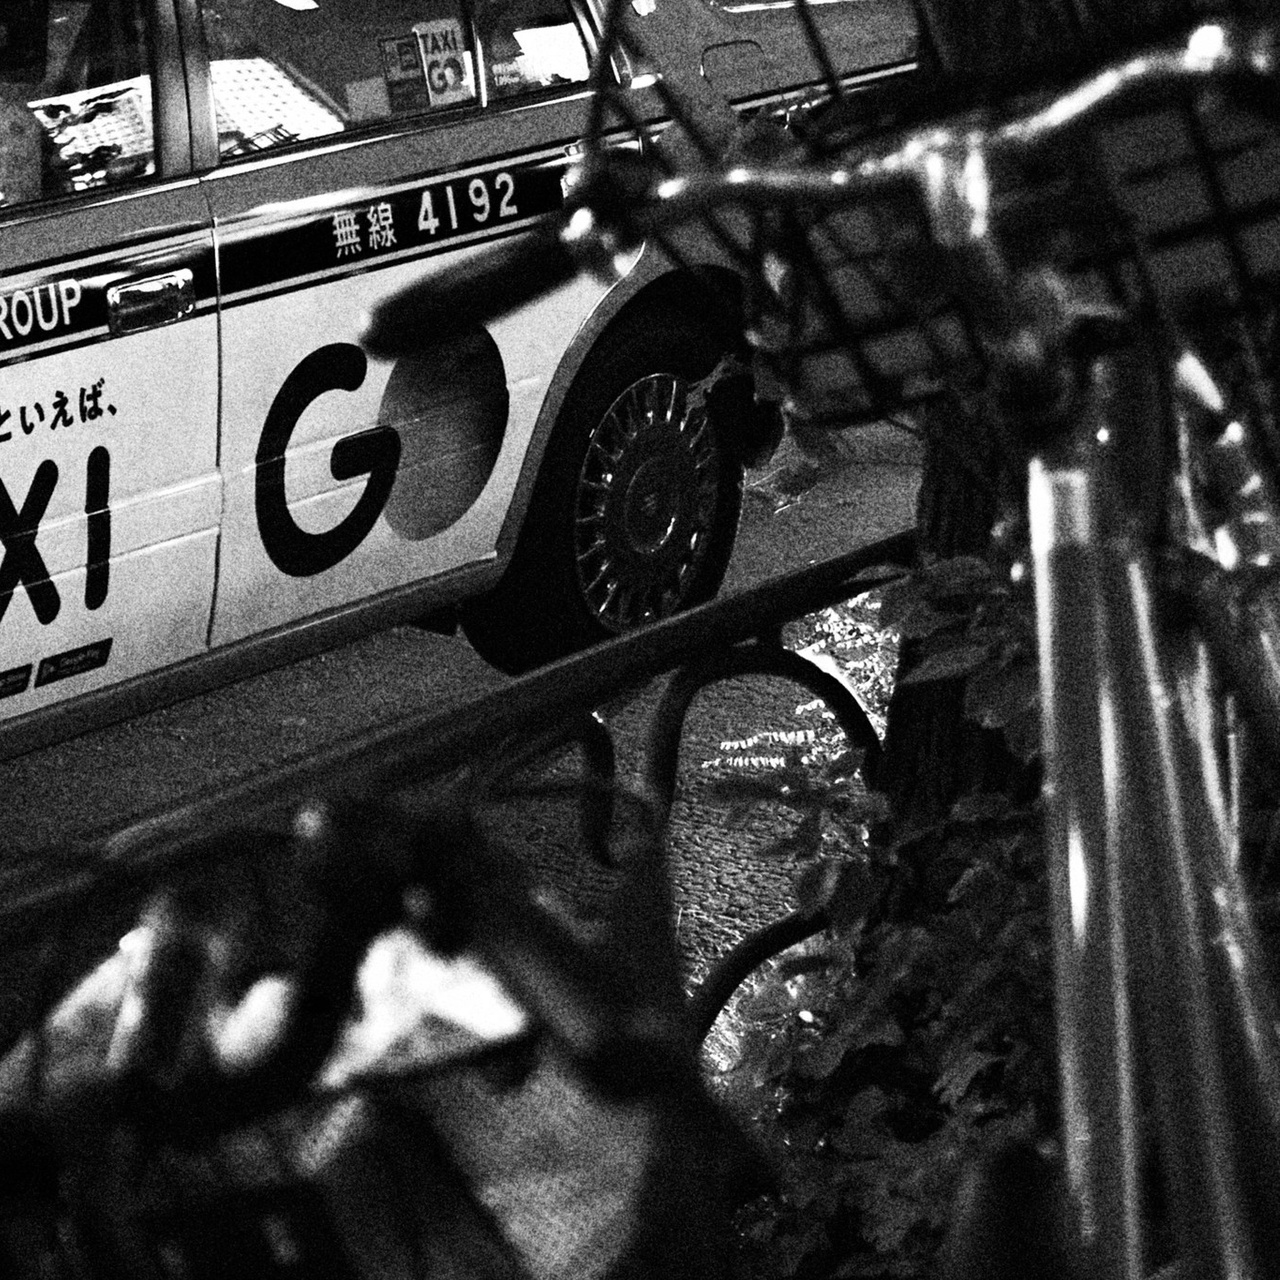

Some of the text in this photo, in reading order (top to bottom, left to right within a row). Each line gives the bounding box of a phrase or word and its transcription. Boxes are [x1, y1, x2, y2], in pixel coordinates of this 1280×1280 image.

[331, 172, 519, 259] 無線 4192
[255, 324, 510, 578] GO
